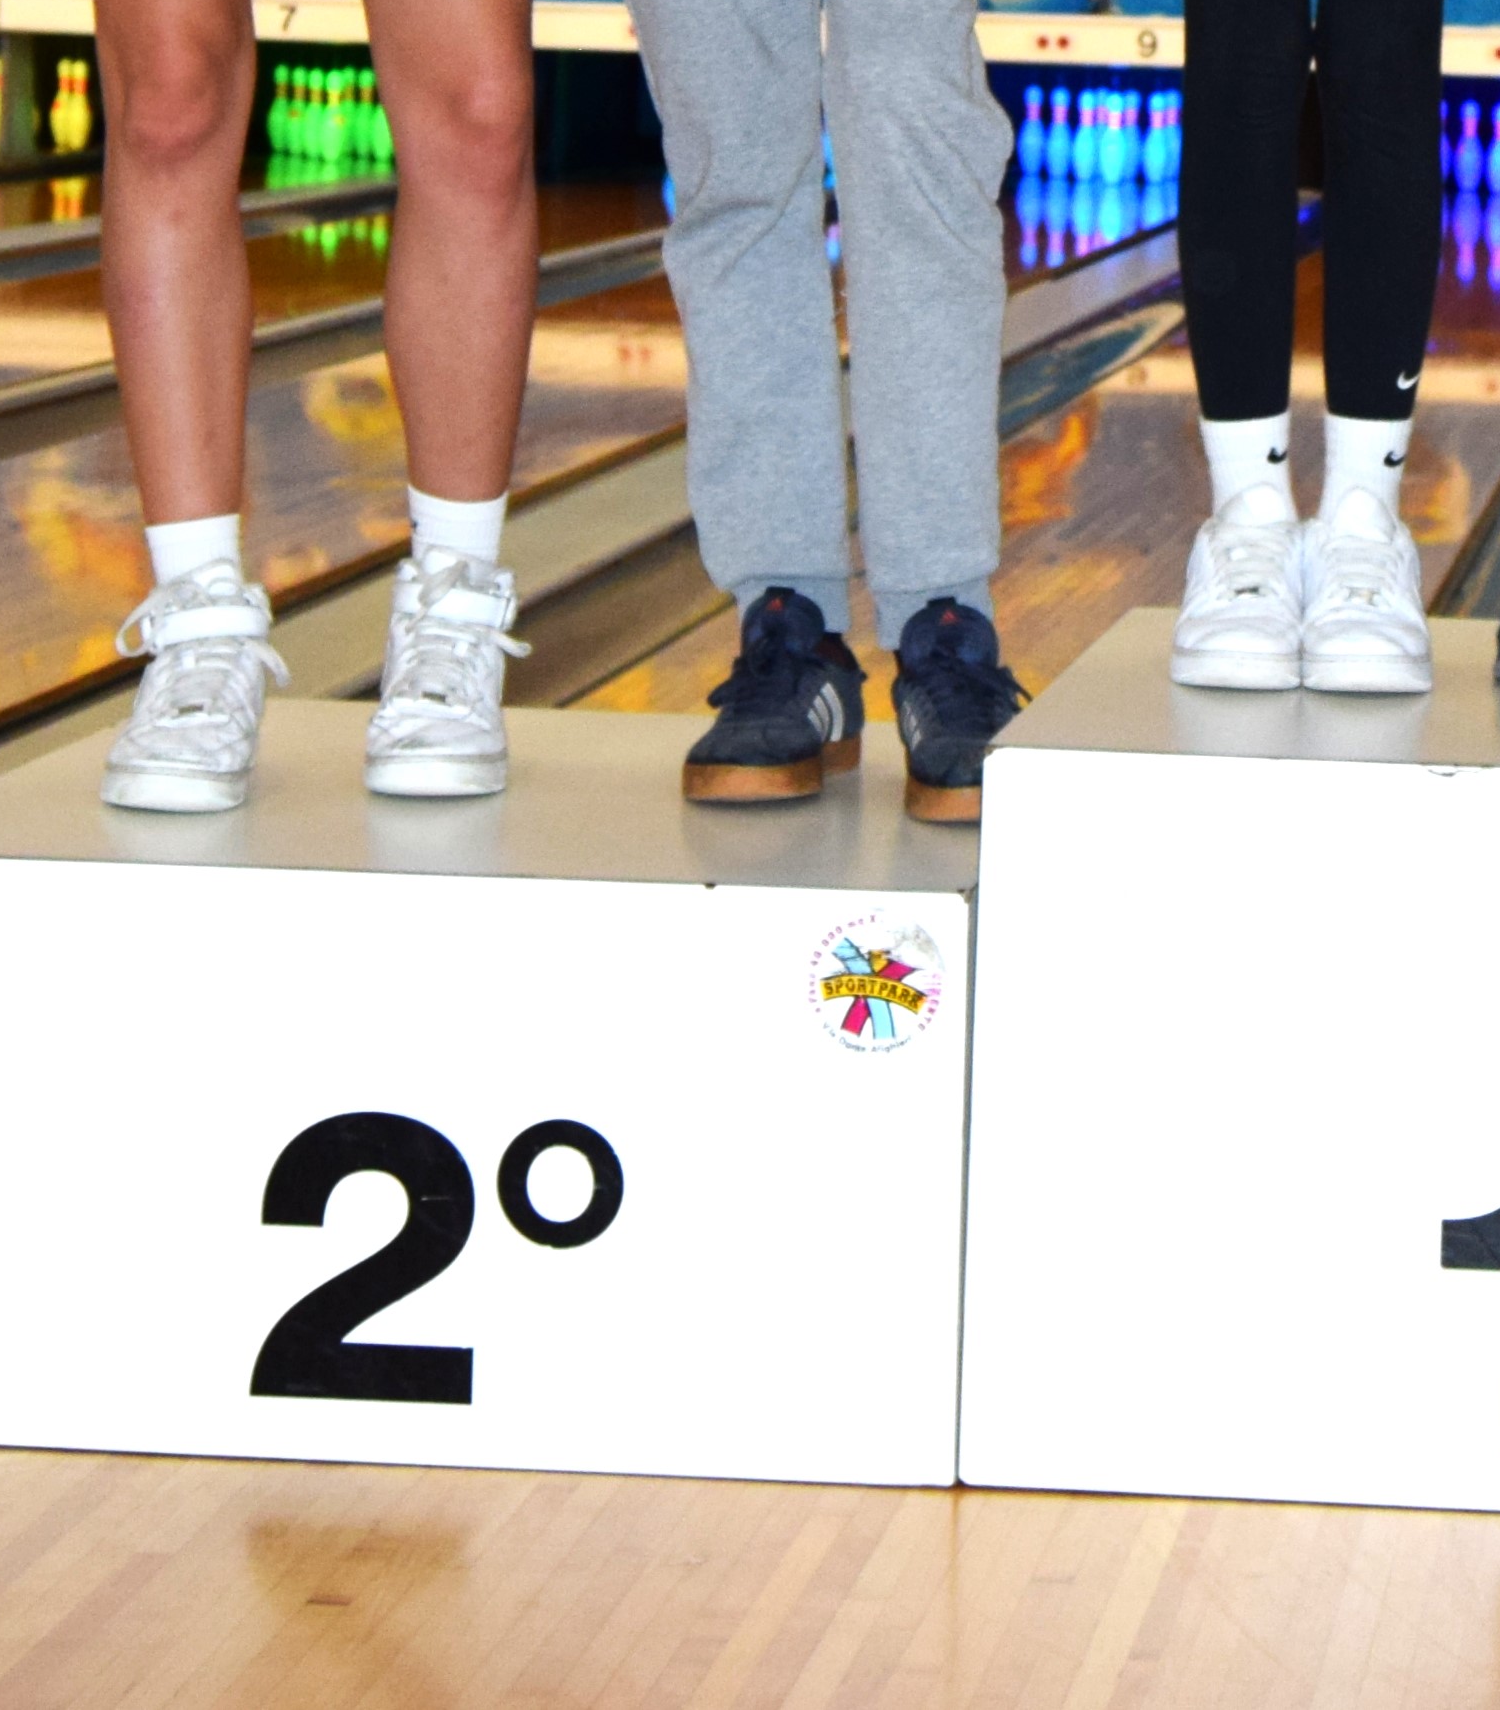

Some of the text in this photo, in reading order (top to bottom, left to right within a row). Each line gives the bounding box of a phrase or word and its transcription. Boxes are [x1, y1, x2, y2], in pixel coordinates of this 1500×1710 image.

[279, 3, 297, 32] 7
[1137, 30, 1157, 59] 9
[823, 977, 924, 1009] SPORTPARK
